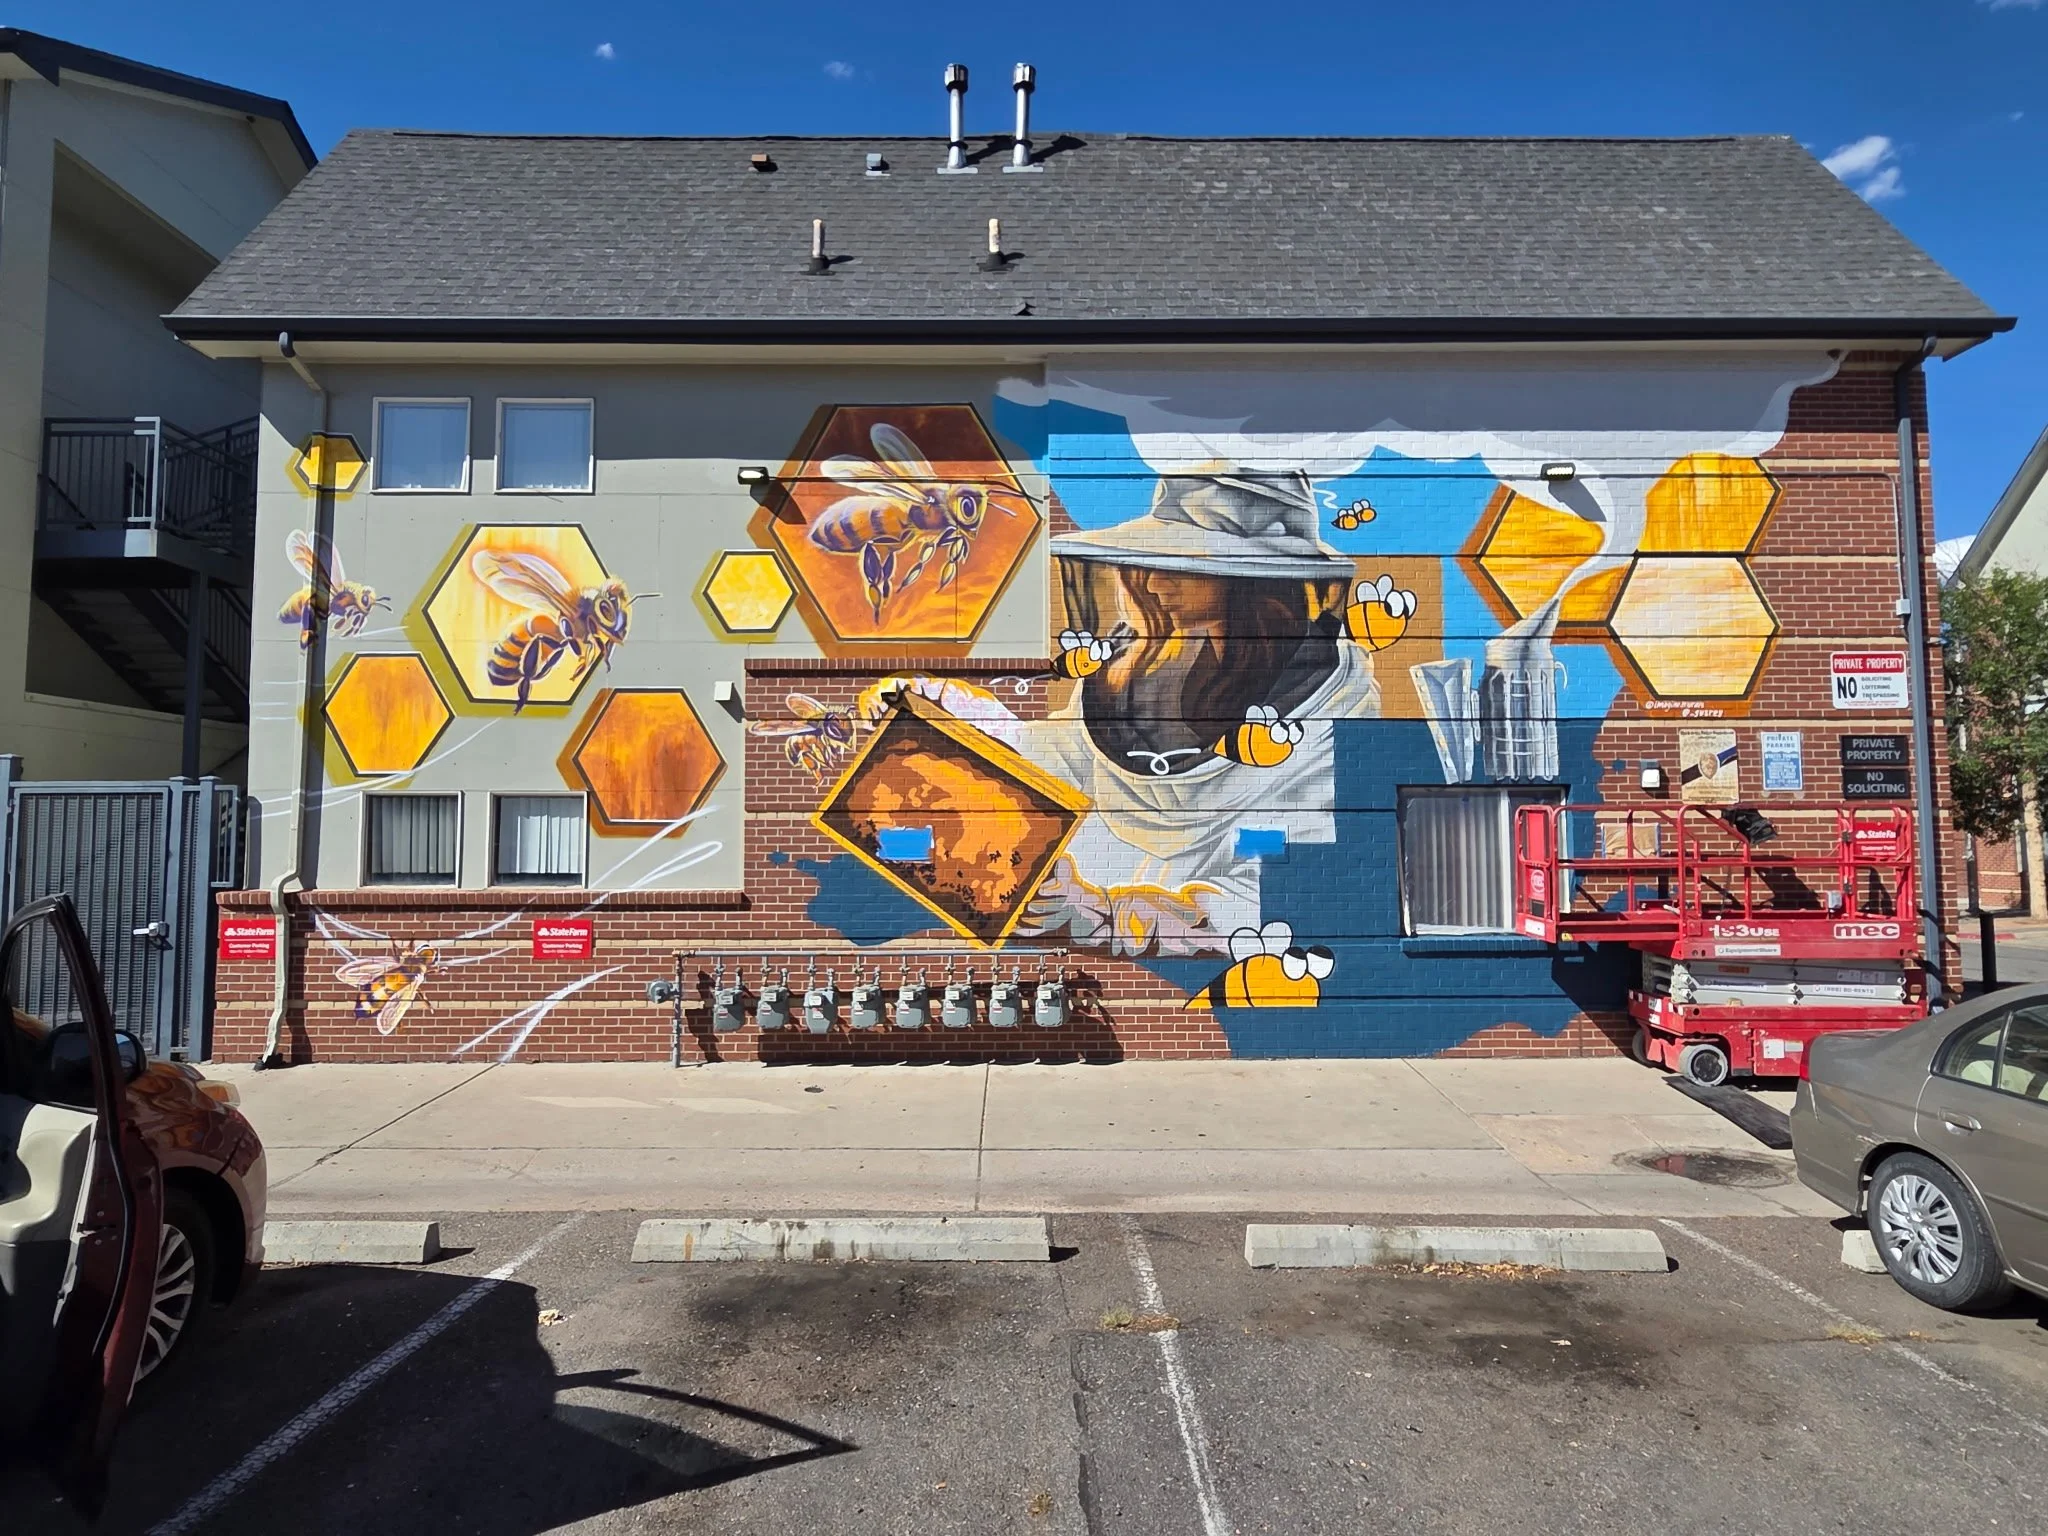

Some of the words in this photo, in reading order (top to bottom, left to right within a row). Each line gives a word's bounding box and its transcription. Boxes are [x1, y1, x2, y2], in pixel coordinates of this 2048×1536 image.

[1834, 658, 1864, 669] PRIVATE
[1866, 658, 1903, 669] PROPERTY
[1837, 676, 1857, 699] NO
[1852, 738, 1895, 748] PRIVATE
[1846, 750, 1901, 760] PROPERTY
[1866, 772, 1884, 782] NO
[1847, 784, 1905, 793] SOLICITING
[1836, 925, 1898, 937] mec
